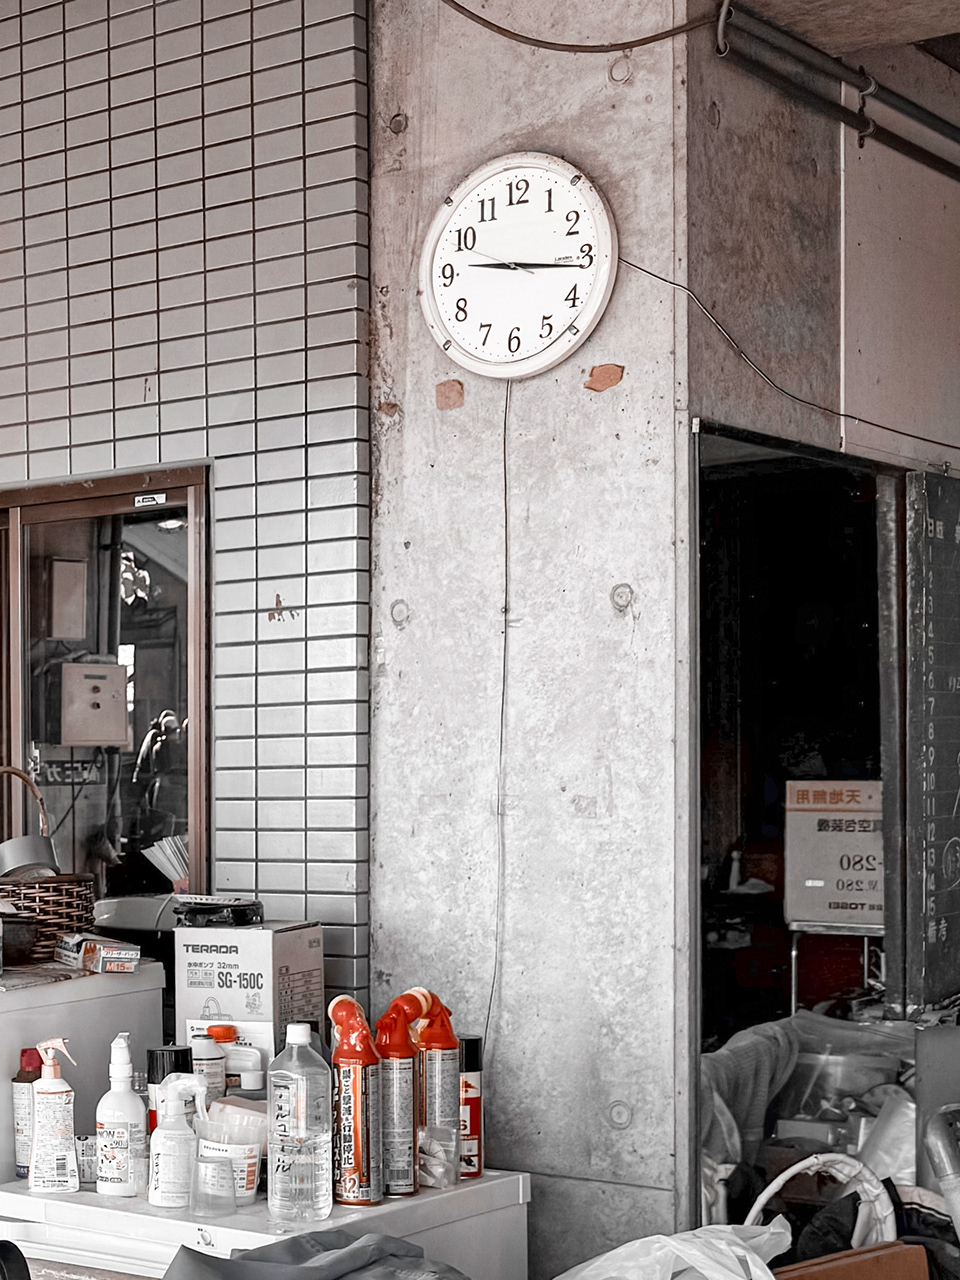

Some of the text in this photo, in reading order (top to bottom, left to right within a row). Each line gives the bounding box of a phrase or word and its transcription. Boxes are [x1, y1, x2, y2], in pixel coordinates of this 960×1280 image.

[506, 179, 530, 206] 12
[544, 188, 555, 213] 1
[478, 197, 498, 222] 11
[565, 211, 580, 236] 2
[454, 226, 476, 252] 10
[579, 243, 594, 269] 3
[441, 263, 455, 288] 9
[564, 283, 580, 309] 4
[454, 297, 468, 322] 8
[479, 322, 492, 346] 7
[539, 314, 553, 339] 5
[507, 327, 521, 353] 6
[927, 545, 933, 562] 1
[928, 571, 934, 588] 2
[927, 596, 934, 614] 3
[928, 621, 934, 638] 4
[928, 646, 934, 664] 5
[928, 672, 934, 689] 6
[928, 697, 935, 715] 7
[928, 722, 934, 740] 8
[928, 747, 935, 766] 9
[927, 773, 936, 791] 10
[927, 797, 936, 816] 11
[927, 823, 936, 841] 12
[927, 848, 935, 867] 13
[927, 897, 936, 916] 15
[183, 944, 239, 954] TERADA
[218, 971, 264, 989] SG-150C
